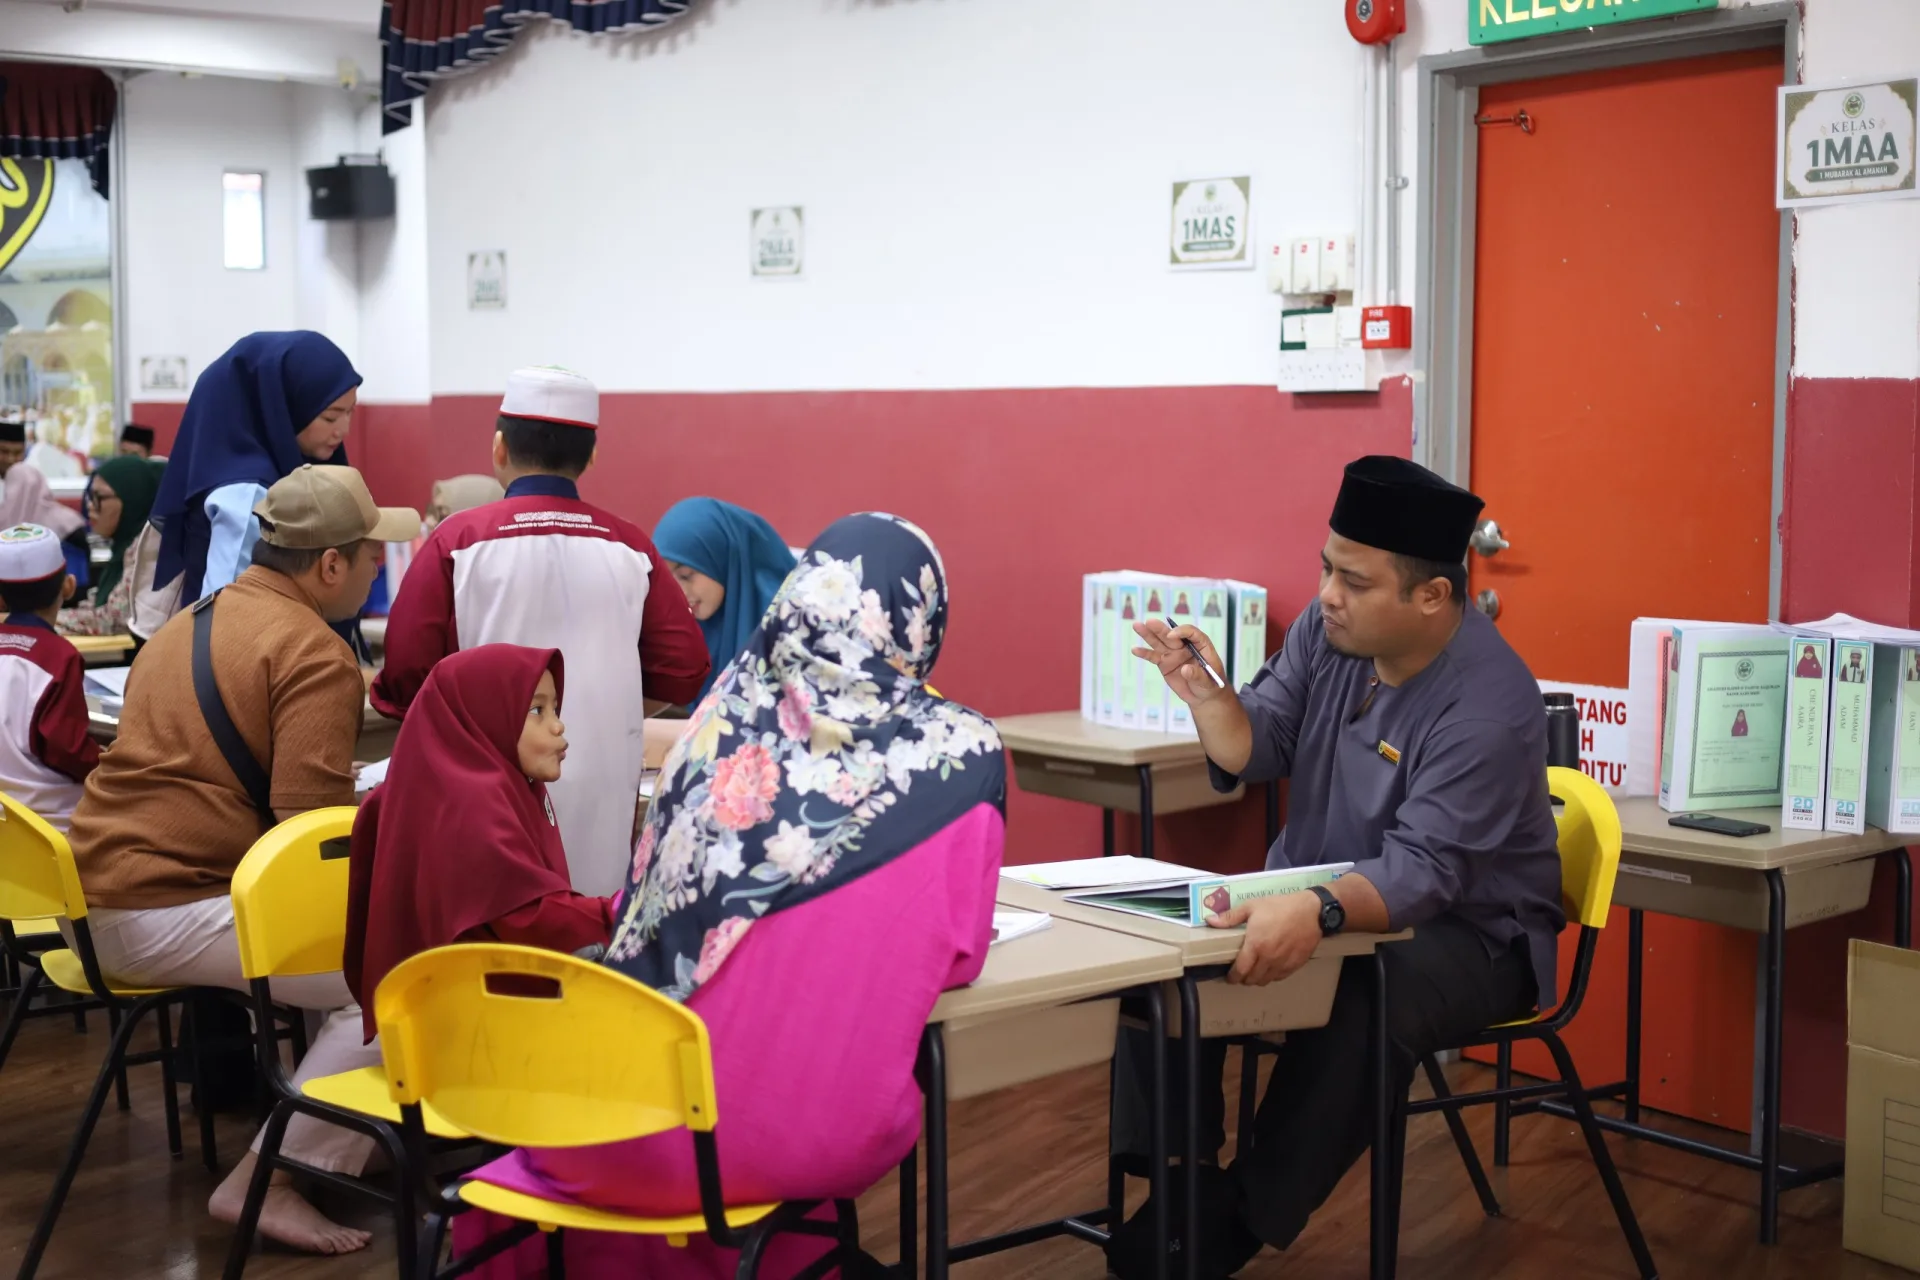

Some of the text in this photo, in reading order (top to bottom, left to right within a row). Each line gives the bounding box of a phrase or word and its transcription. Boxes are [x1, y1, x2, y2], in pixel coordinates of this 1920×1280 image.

[1831, 118, 1876, 133] KELAS
[1806, 132, 1899, 167] 1MAA
[1824, 169, 1853, 179] MUBARAK
[1854, 168, 1862, 176] AL
[1863, 166, 1888, 175] AMANAH
[1183, 216, 1236, 240] 1MAS
[1797, 705, 1805, 730] AAIRA
[1808, 706, 1816, 723] NUR
[1840, 705, 1848, 729] ADAM
[1851, 694, 1861, 743] MUHAMMAD
[1807, 724, 1815, 747] HANA
[1579, 758, 1627, 786] DITU
[1793, 797, 1814, 810] 2D
[1836, 801, 1856, 813] 2D
